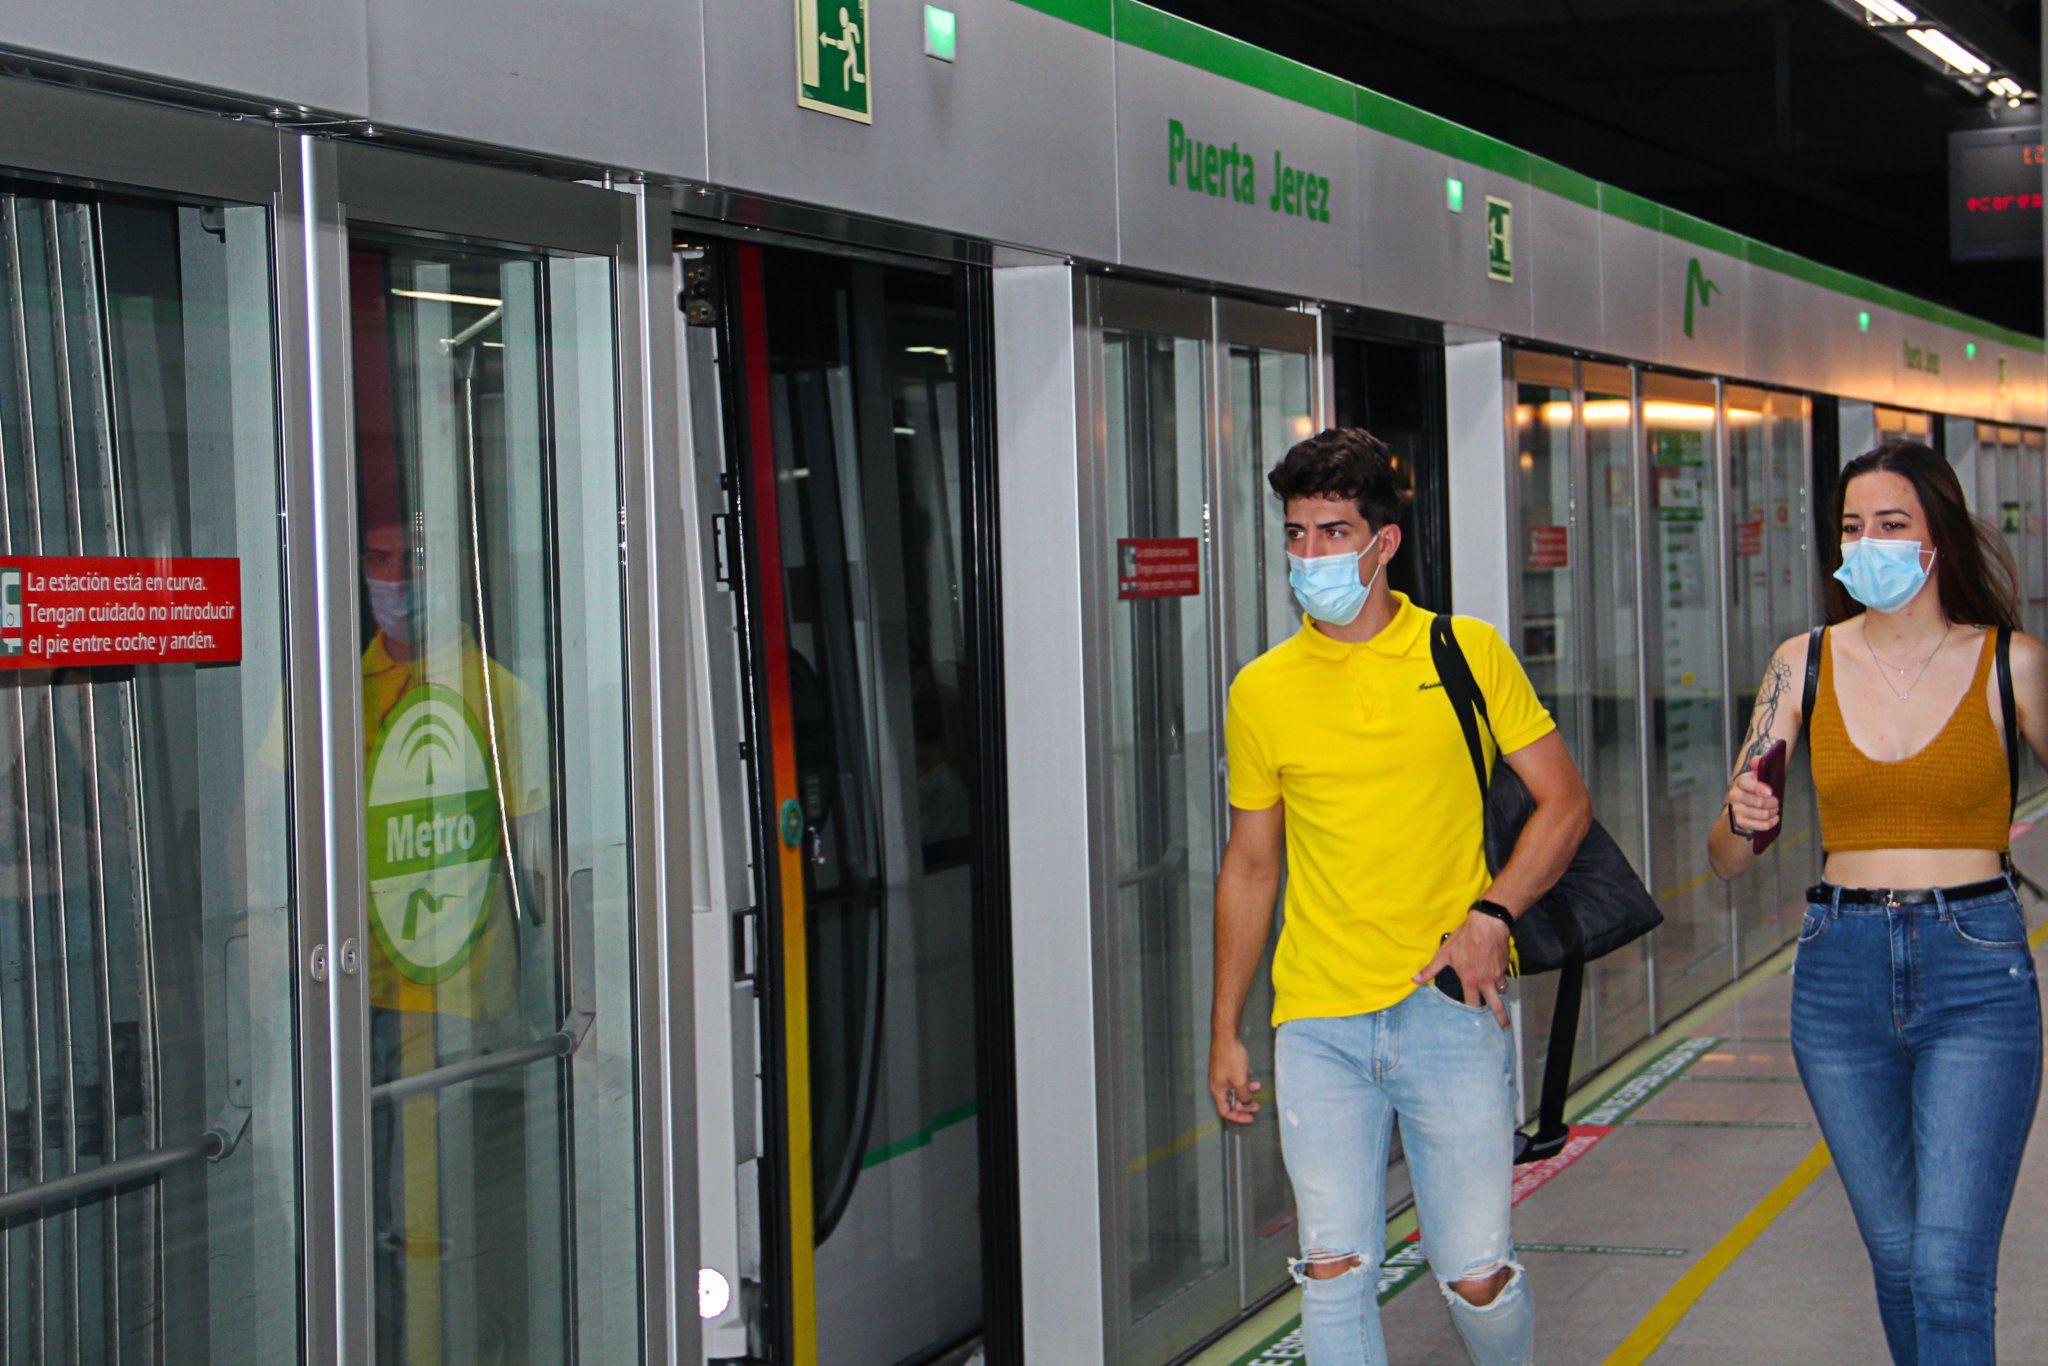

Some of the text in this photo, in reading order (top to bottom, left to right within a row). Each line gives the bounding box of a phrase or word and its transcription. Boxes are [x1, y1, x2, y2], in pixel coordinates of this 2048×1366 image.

[1168, 118, 1330, 224] Puerta Jerez
[27, 572, 207, 592] La estación está en curva.
[28, 601, 235, 628] Tengan cuidado no introducir
[28, 630, 216, 659] el pie entre coche y andén.
[386, 812, 476, 863] Metro
